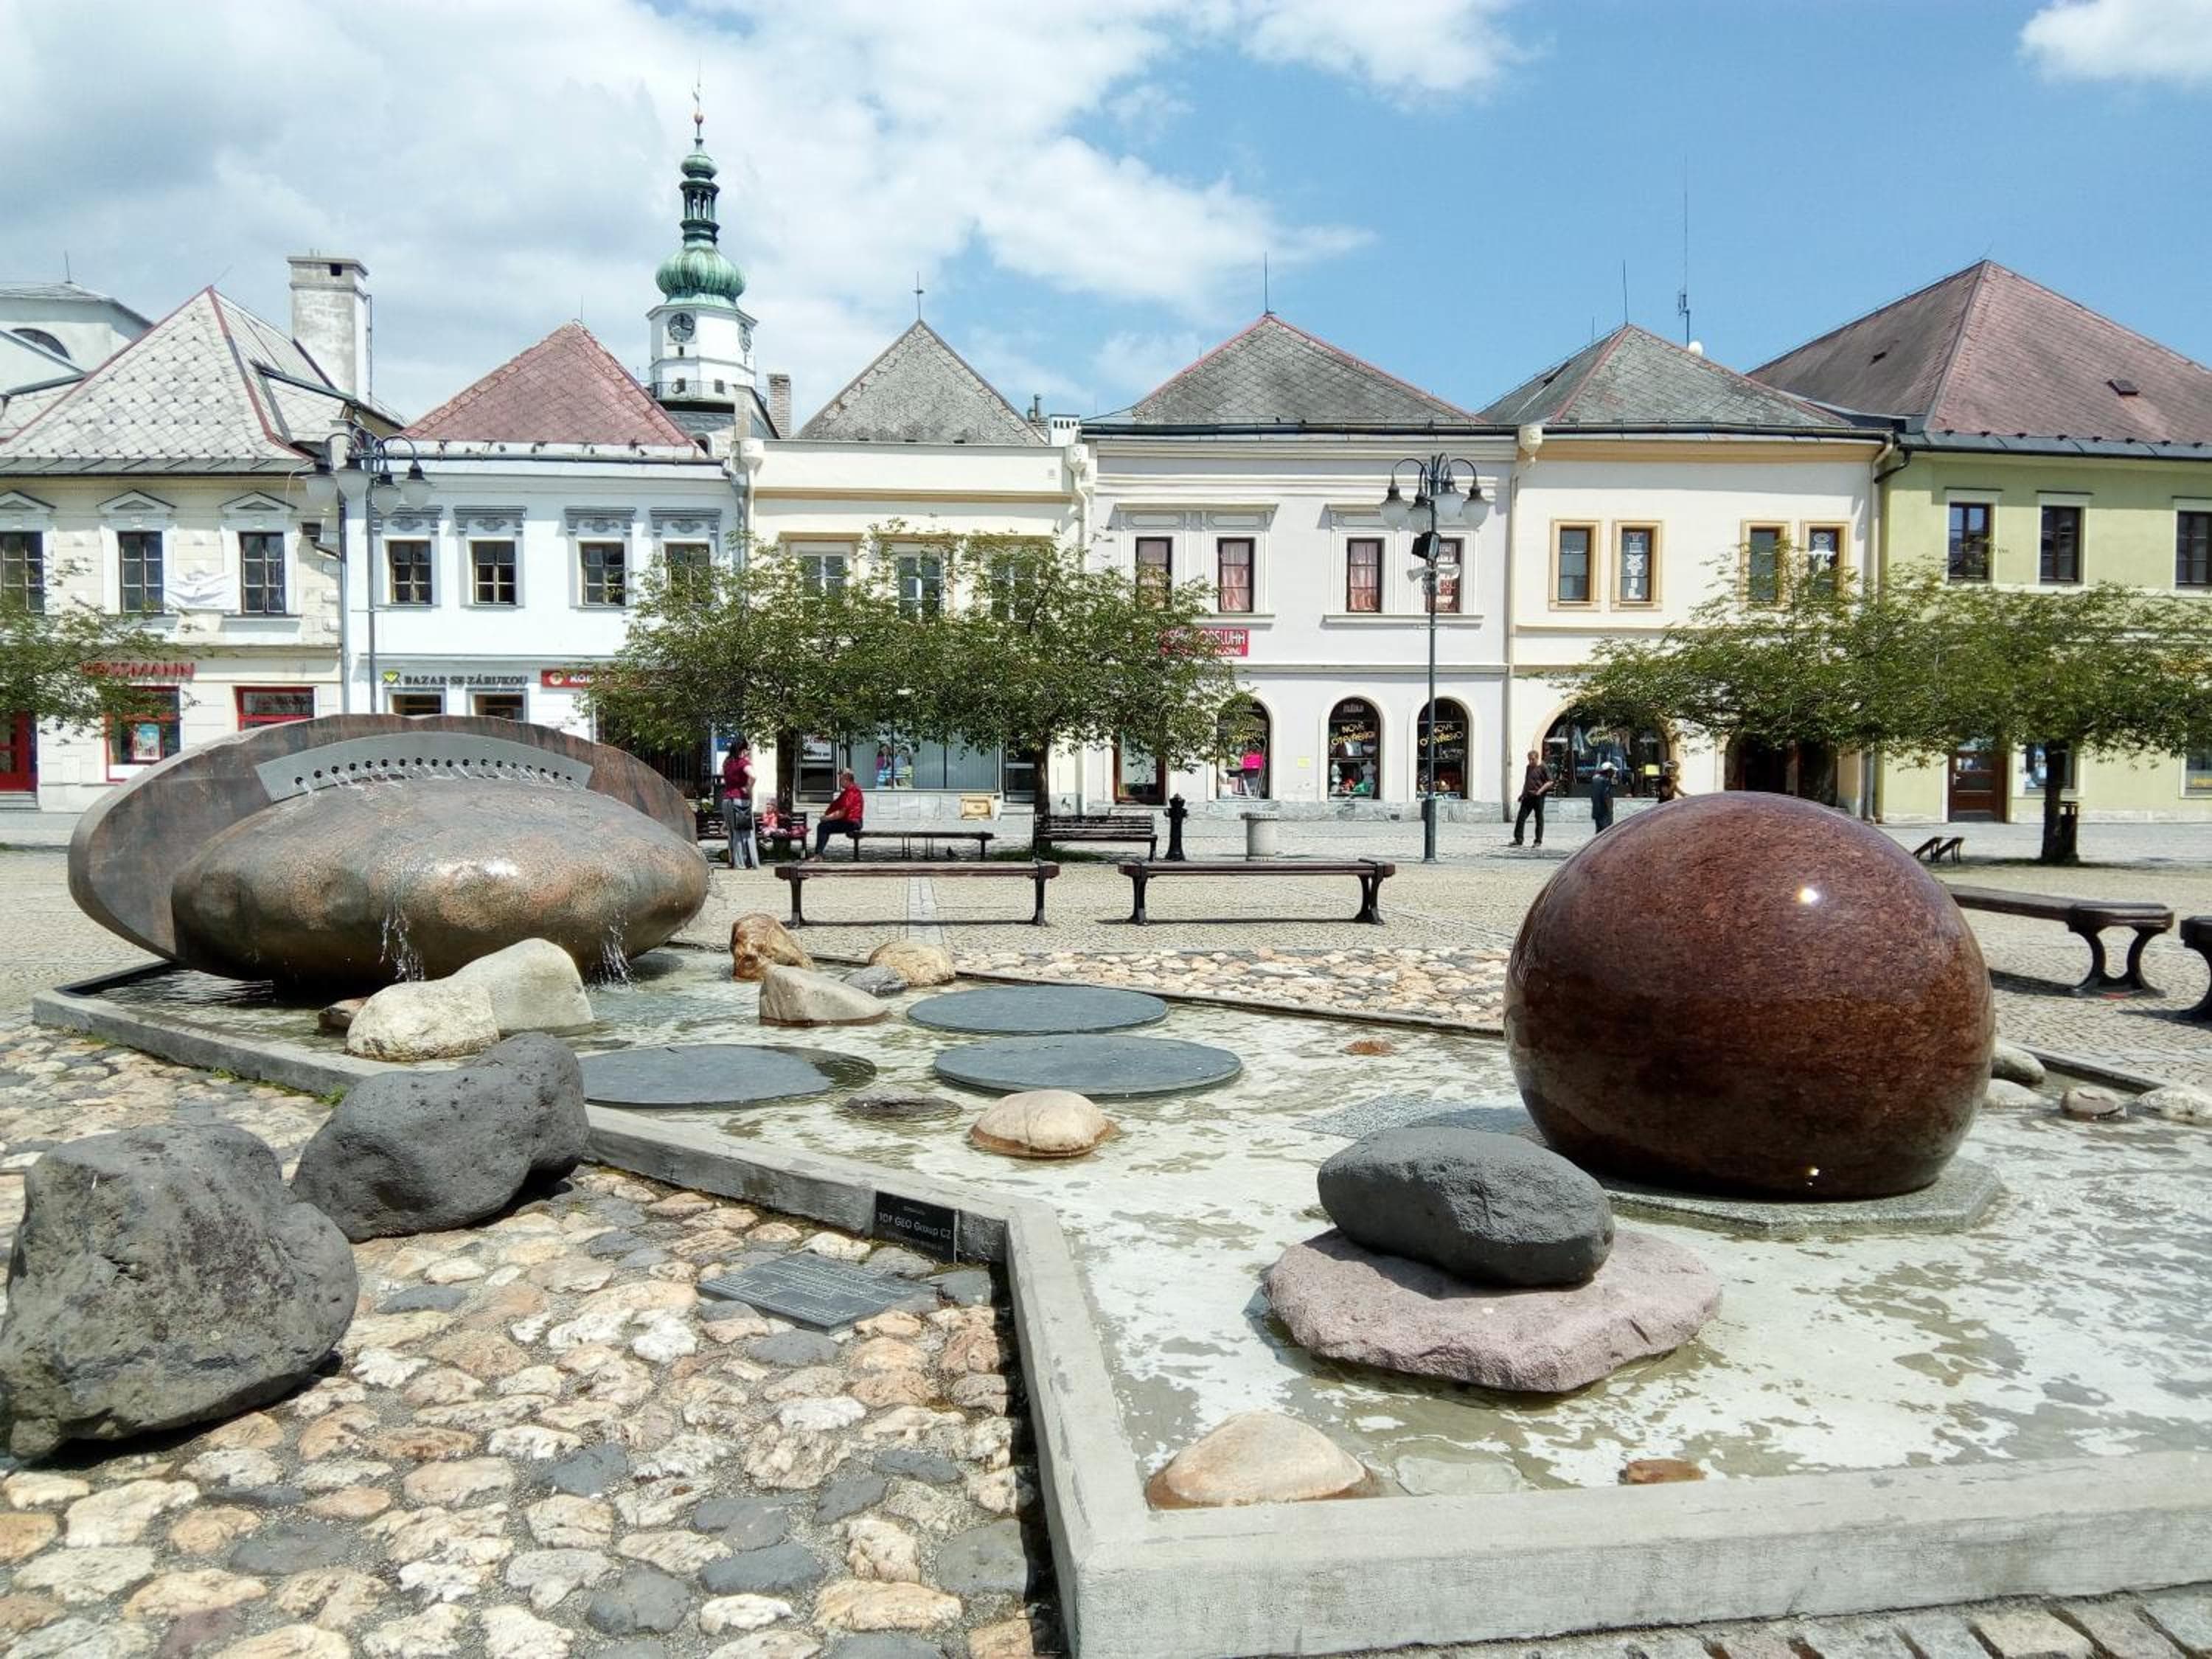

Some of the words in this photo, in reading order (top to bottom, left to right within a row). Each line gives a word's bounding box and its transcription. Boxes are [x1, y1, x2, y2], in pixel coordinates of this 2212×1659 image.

[1626, 532, 1644, 599] TEXTIL
[404, 676, 445, 684] BAZAR
[467, 673, 529, 685] ZÁRUKOU
